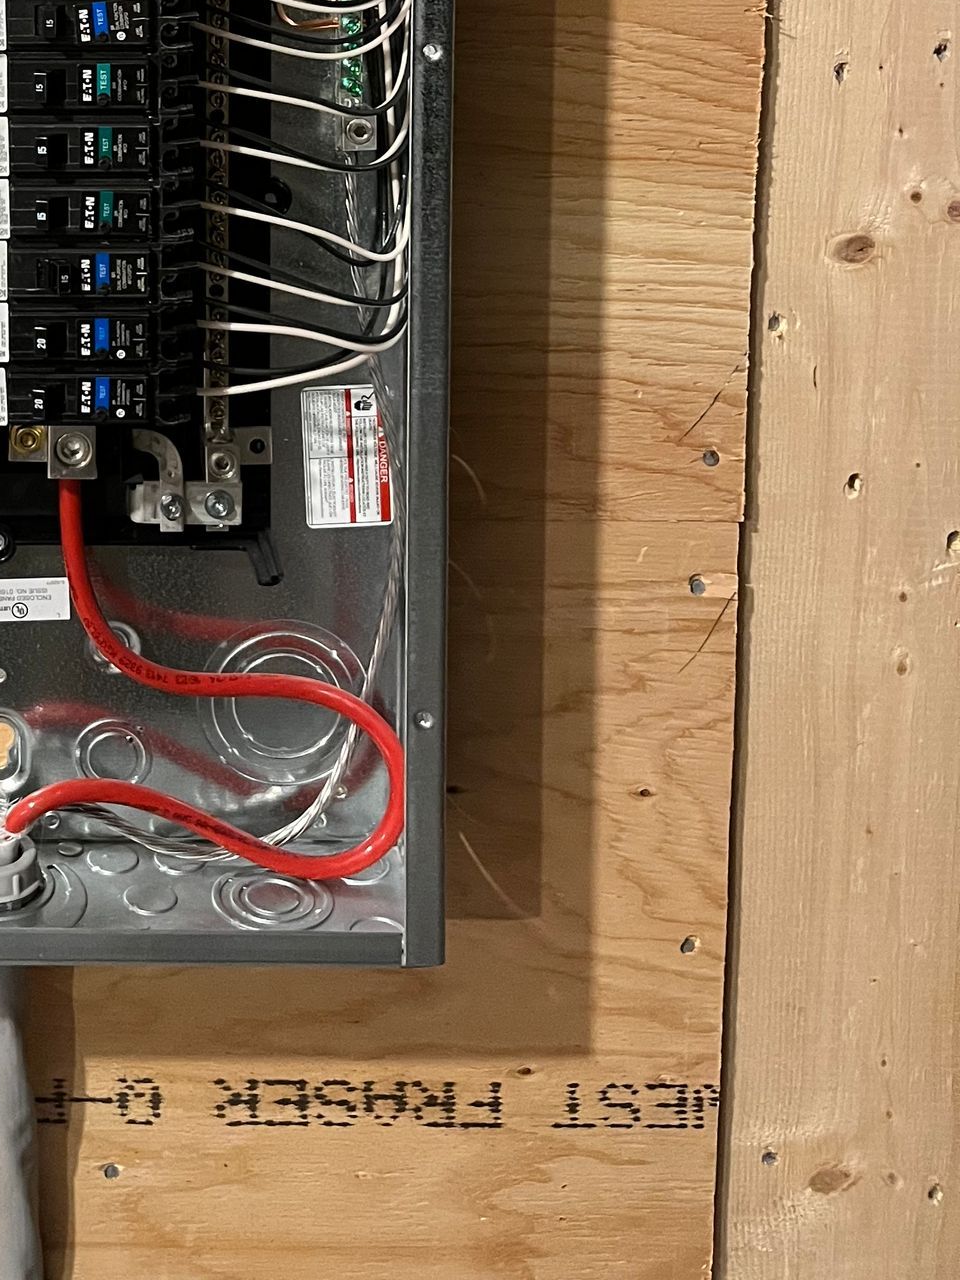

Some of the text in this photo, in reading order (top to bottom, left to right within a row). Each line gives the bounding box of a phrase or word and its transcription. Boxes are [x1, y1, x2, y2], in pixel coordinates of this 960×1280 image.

[46, 19, 54, 28] 15
[100, 70, 108, 90] TEST
[35, 83, 44, 92] 15
[37, 146, 48, 155] 15
[37, 211, 47, 221] 15
[61, 274, 68, 283] 15
[36, 338, 47, 350] 20
[34, 398, 44, 409] 20
[379, 441, 388, 483] DANGER
[212, 1076, 502, 1130] FRASER
